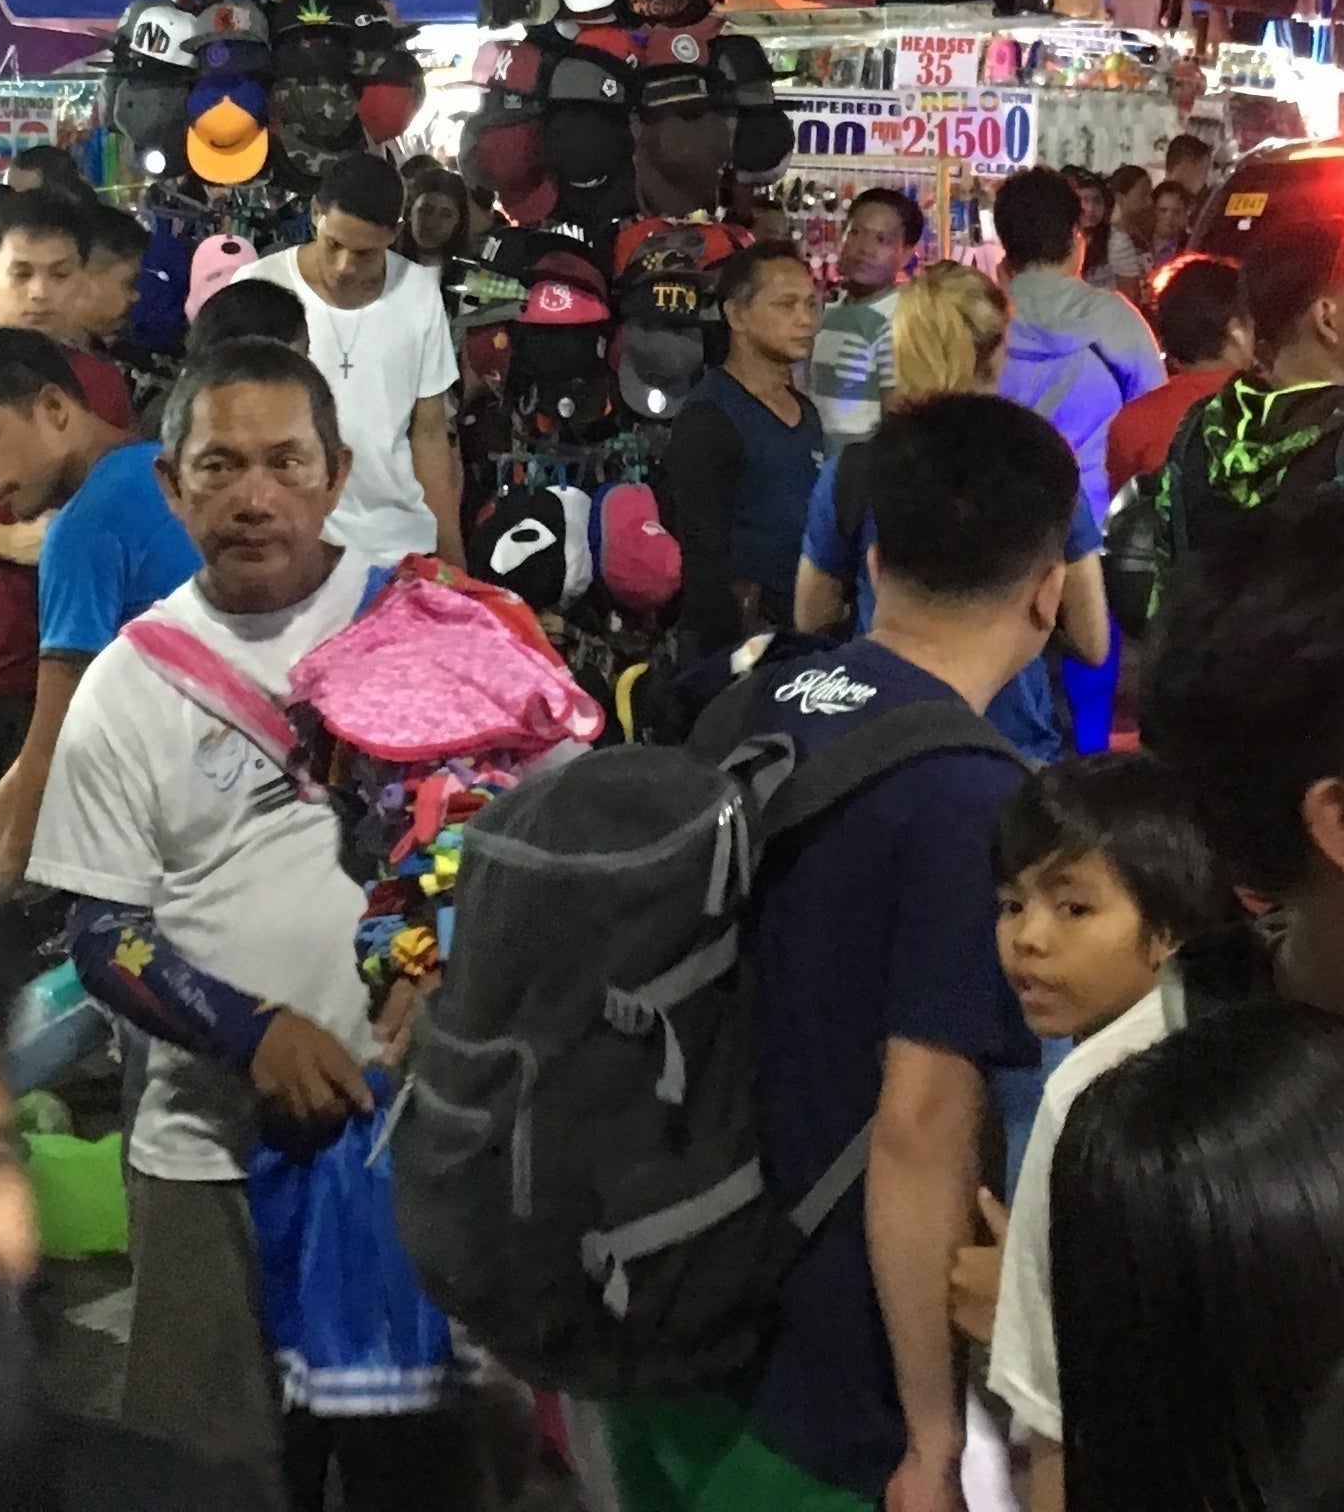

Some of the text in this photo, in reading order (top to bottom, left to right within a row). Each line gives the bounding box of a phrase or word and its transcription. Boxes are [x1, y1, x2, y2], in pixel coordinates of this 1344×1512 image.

[901, 35, 976, 54] HEADSET
[916, 53, 954, 86] 35
[920, 90, 999, 113] RELO
